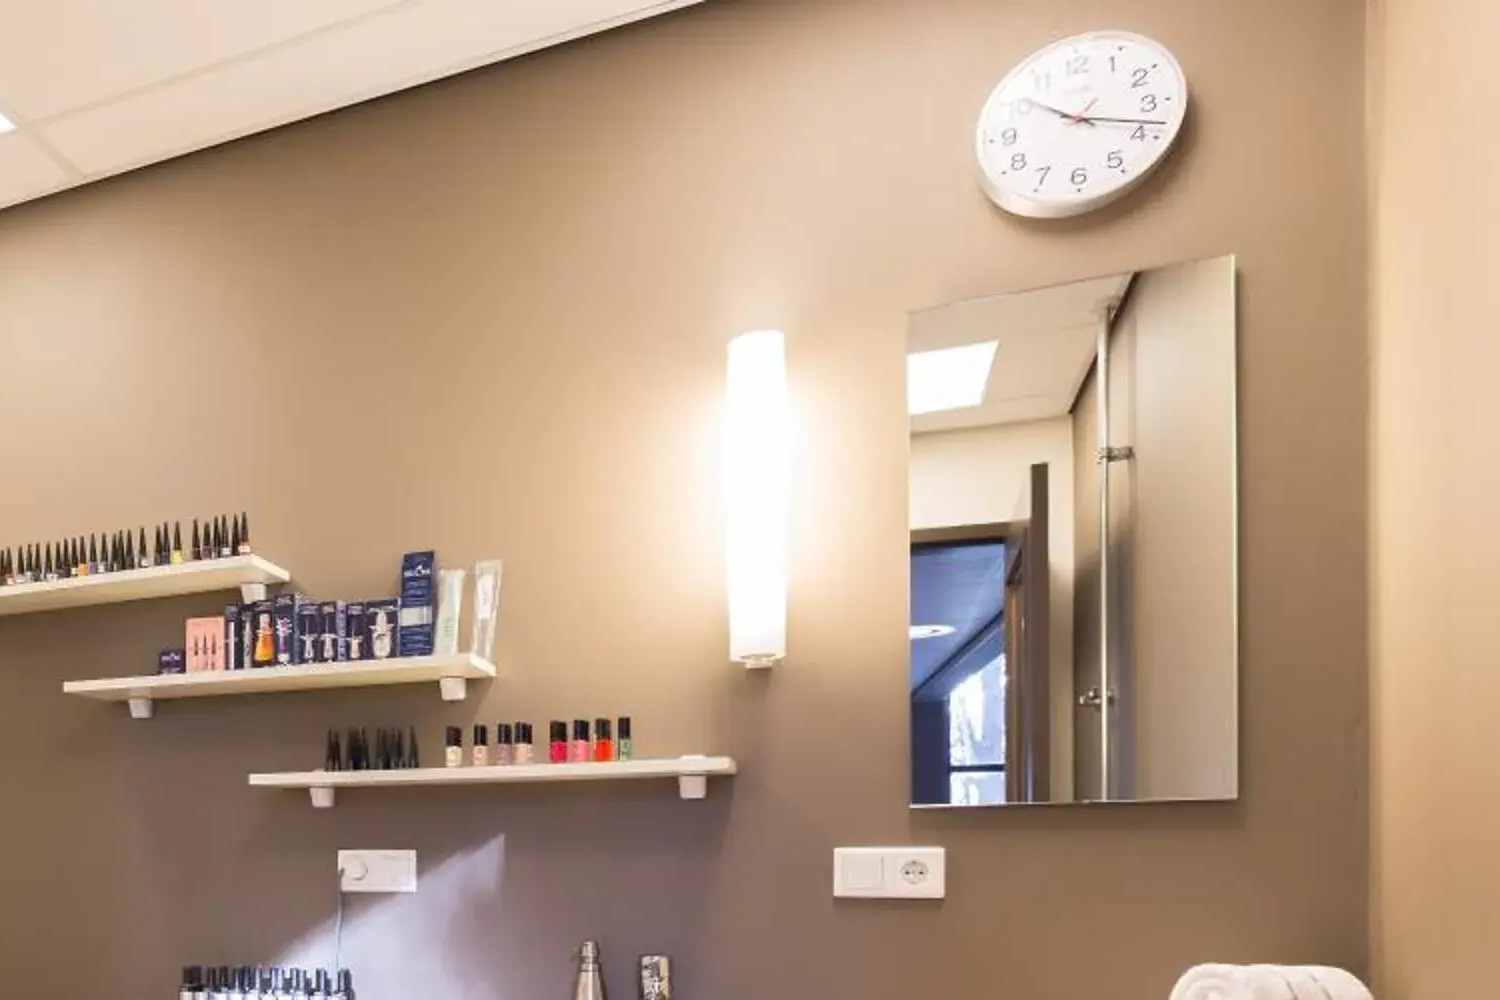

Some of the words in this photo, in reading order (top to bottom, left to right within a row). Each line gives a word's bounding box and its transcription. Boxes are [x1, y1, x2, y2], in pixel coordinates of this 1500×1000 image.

[1065, 55, 1089, 77] 12
[1108, 55, 1116, 73] 1
[1033, 73, 1051, 95] 11
[1131, 67, 1150, 89] 2
[1140, 94, 1157, 113] 3
[1001, 127, 1018, 146] 9
[1129, 125, 1146, 142] 4
[1011, 153, 1027, 171] 8
[1107, 149, 1124, 170] 5
[1035, 165, 1051, 187] 7
[1070, 167, 1088, 186] 6
